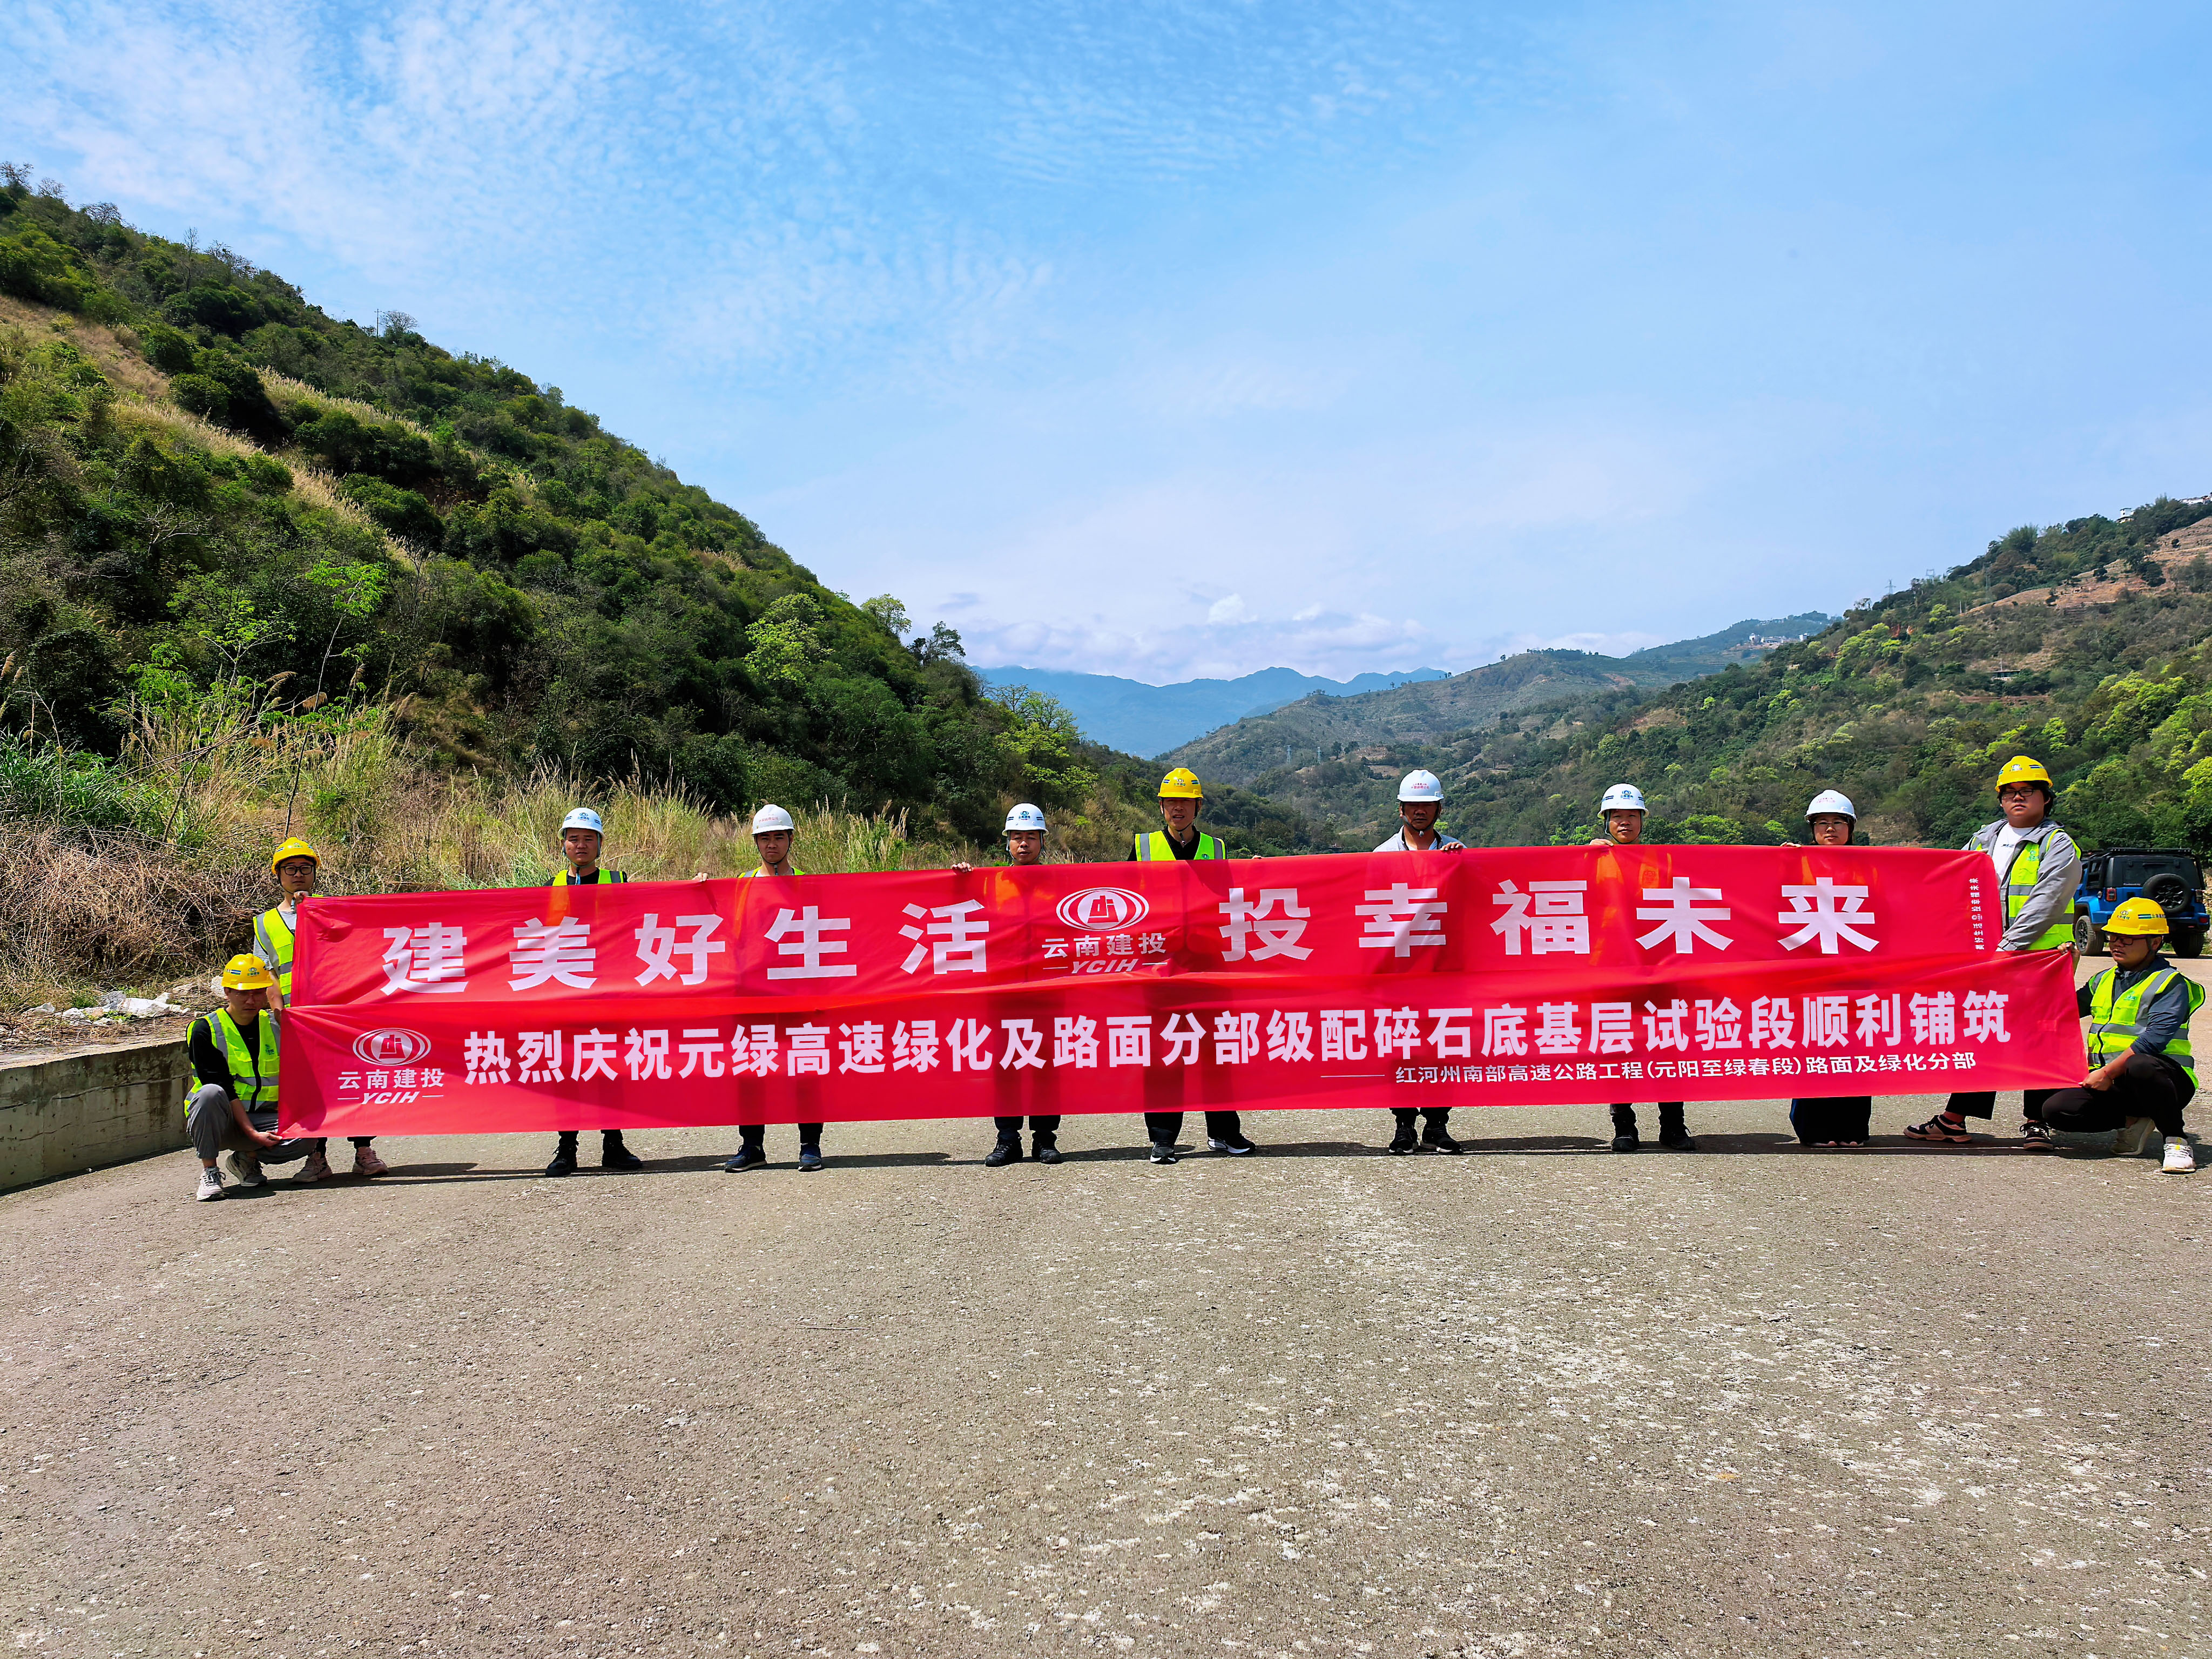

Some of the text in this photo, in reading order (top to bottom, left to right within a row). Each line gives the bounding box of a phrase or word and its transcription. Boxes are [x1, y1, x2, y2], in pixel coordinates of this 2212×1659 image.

[380, 877, 1879, 995] 建美好生活 投幸福未来
[1042, 933, 1166, 959] 云南建投
[1071, 959, 1138, 974] YCIH
[464, 990, 2011, 1085] 热烈庆祝元绿高速绿化及路面分部级配碎石底基层试验段顺利铺筑
[338, 1068, 444, 1089] 云南建投
[360, 1091, 421, 1105] YCIH
